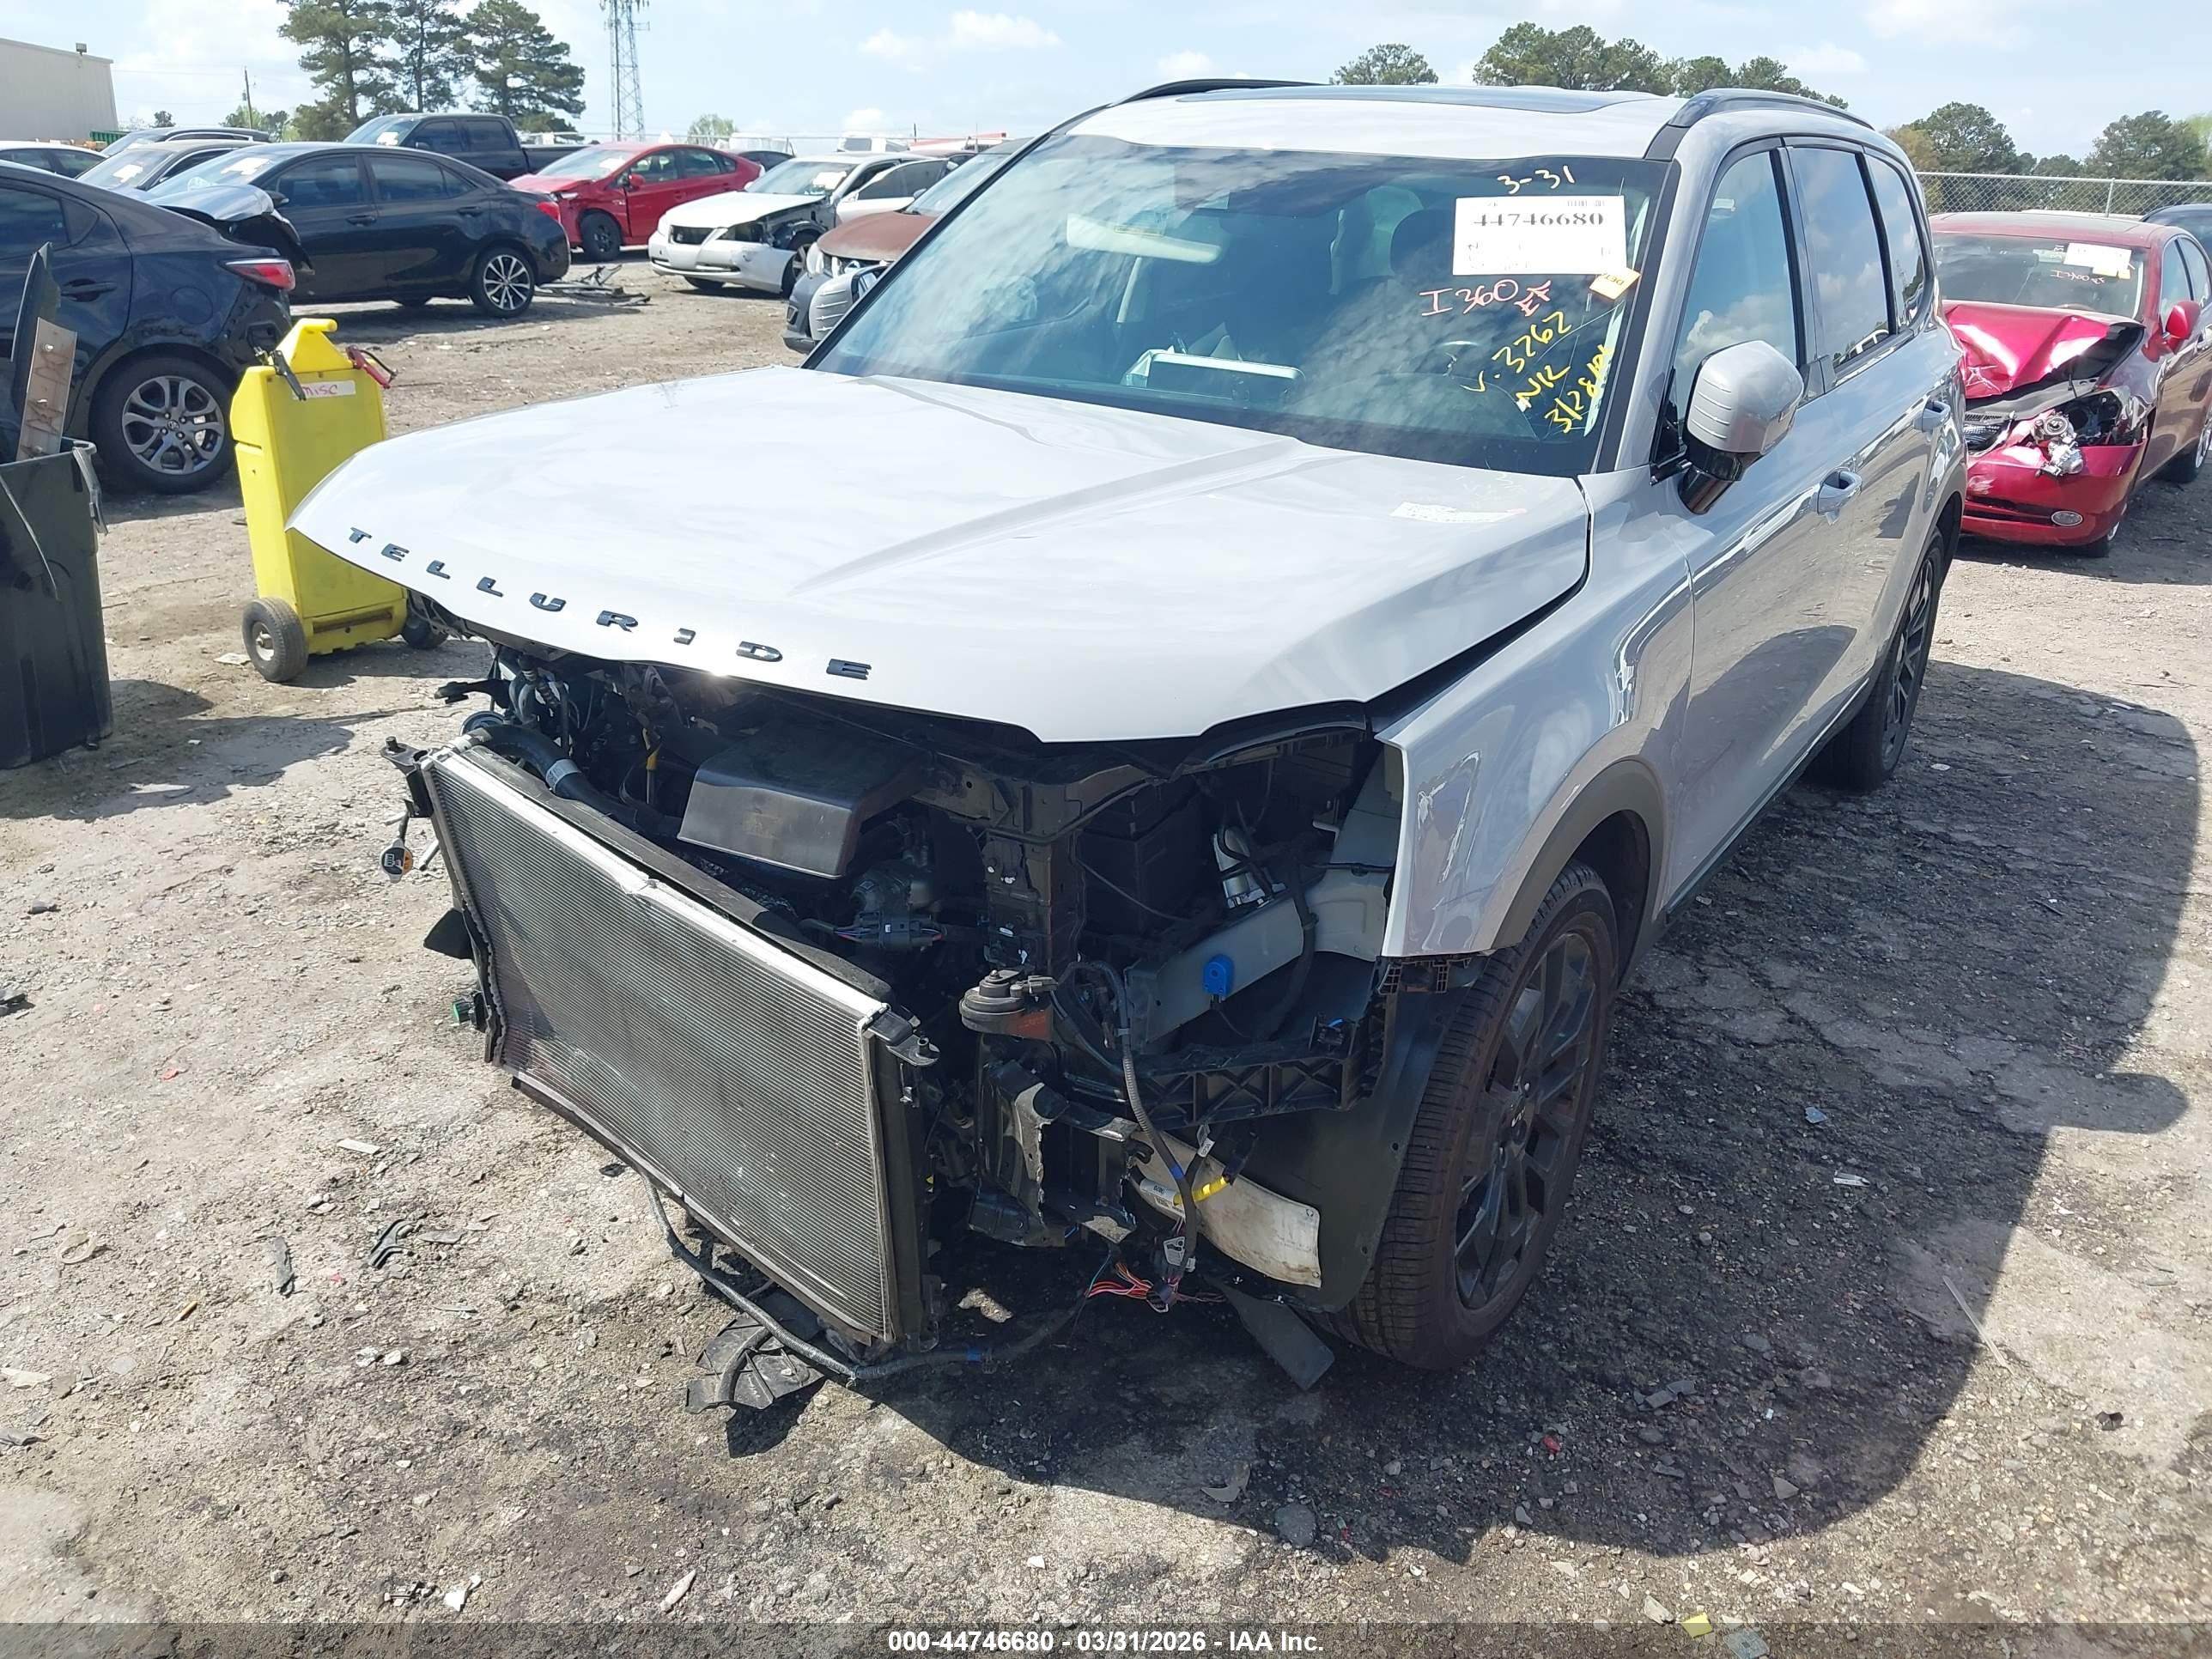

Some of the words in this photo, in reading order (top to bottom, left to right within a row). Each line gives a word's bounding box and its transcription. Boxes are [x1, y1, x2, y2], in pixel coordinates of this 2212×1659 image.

[1497, 165, 1575, 194] 3-31
[1474, 212, 1604, 227] 44746680
[348, 526, 872, 680] TELLURIDE
